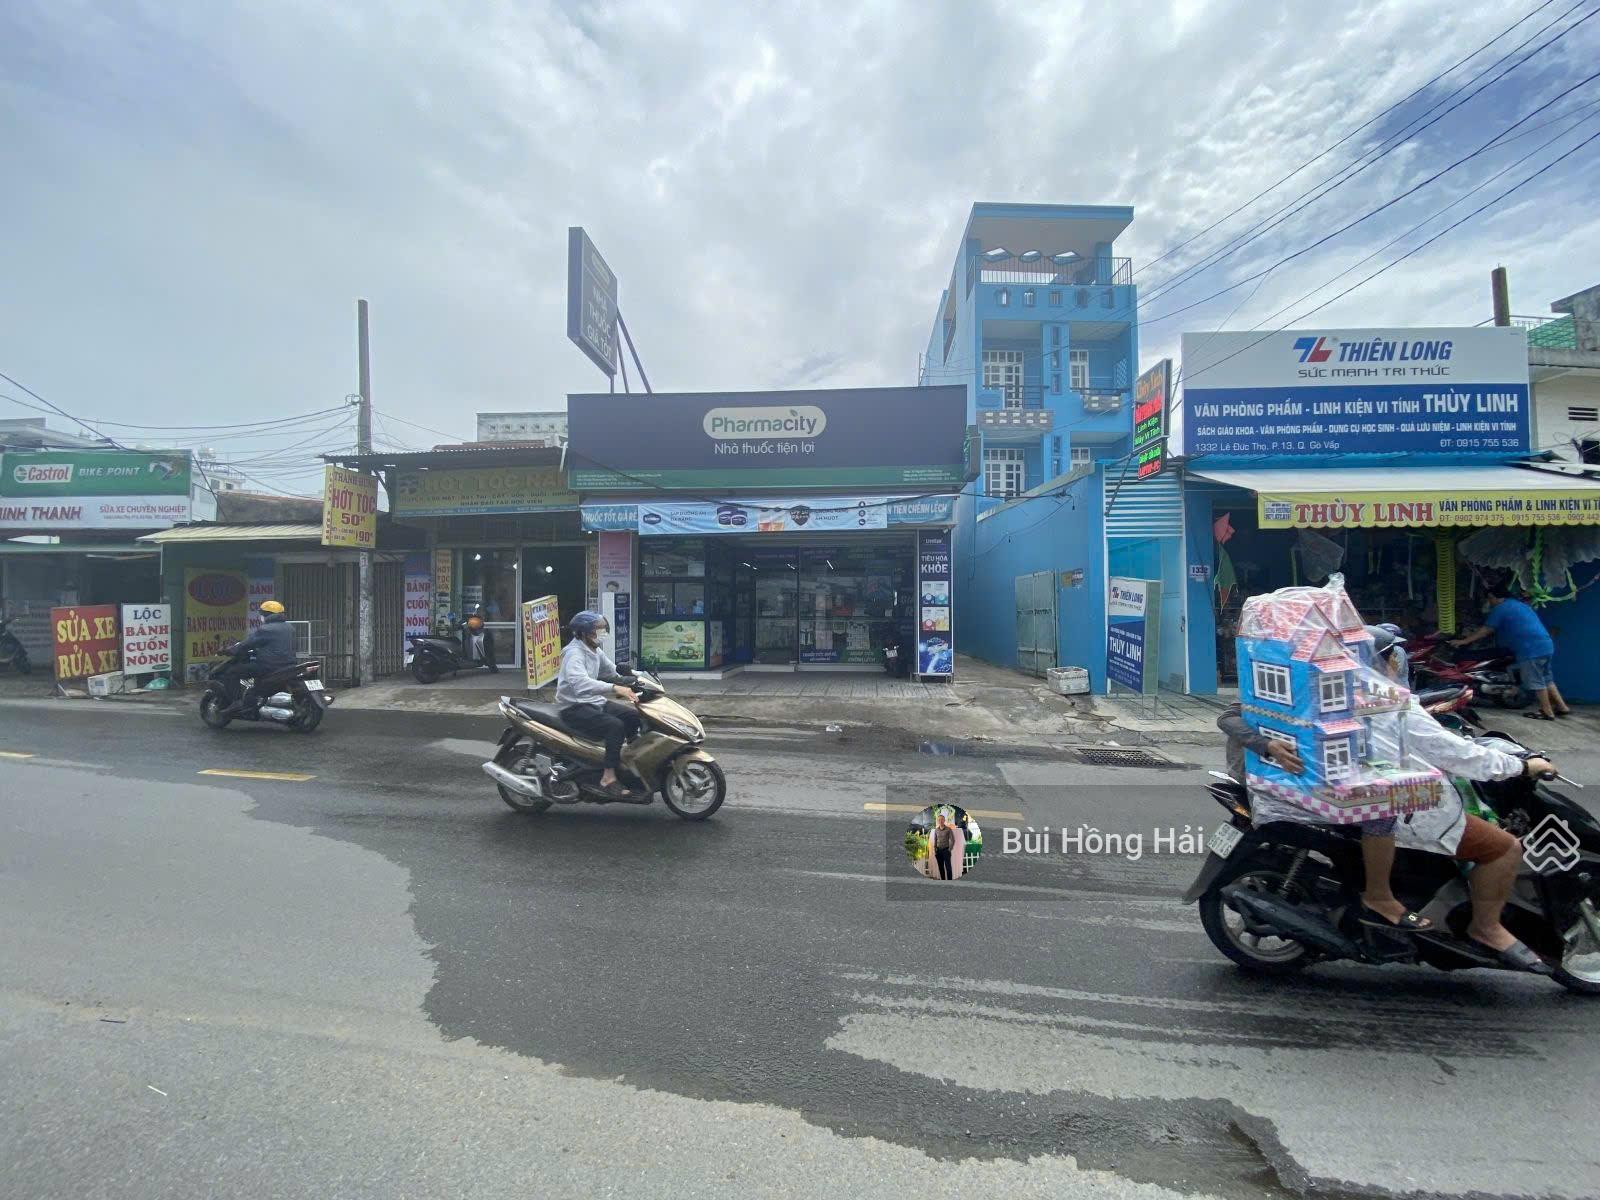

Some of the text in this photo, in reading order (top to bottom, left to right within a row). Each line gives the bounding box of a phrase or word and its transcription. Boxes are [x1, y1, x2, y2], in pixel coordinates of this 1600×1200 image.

[1339, 337, 1397, 362] THIÊN
[1399, 340, 1453, 362] LONG
[1380, 367, 1405, 376] TRI
[1194, 387, 1519, 418] VĂN PHÒNG PHẨM LINH KIỆN VI TÍNH THÙY LINH
[711, 413, 817, 435] Pharmacity
[1197, 424, 1216, 437] SÁCH
[1217, 424, 1234, 436] GIÁO
[1235, 426, 1255, 435] KHOA
[1260, 425, 1275, 435] VĂN
[1277, 423, 1301, 435] PHÒNG
[1302, 421, 1323, 434] PHẨM
[1361, 423, 1376, 435] HỌC
[1377, 423, 1395, 433] SINH
[1456, 422, 1473, 432] LINH
[1491, 422, 1499, 431] VI
[714, 439, 816, 456] Nhà thuốc tiện lợi
[1195, 442, 1218, 452] 1332
[1456, 438, 1480, 448] 0915
[1483, 438, 1499, 447] 755
[1502, 438, 1520, 447] 536
[29, 466, 141, 481] Castrol BIKE POINT
[115, 505, 126, 513] XE
[126, 503, 157, 513] CHUYÊN
[357, 489, 377, 514] TÓC
[908, 500, 930, 514] CHÊNH
[1439, 496, 1591, 514] VĂN PHÒNG PHẨM & LINH KIỆN VI
[1295, 498, 1366, 523] THÙY
[1373, 502, 1434, 523] LINH
[921, 553, 935, 562] TIÊU
[921, 561, 949, 574] KHỎE
[133, 607, 162, 624] LỘC
[57, 610, 91, 644] SỬA
[95, 616, 116, 640] XE
[125, 624, 169, 637] BÁNH
[126, 636, 168, 653] CUỐN
[1125, 642, 1142, 663] LINH
[58, 645, 118, 678] RỬA XE
[126, 652, 169, 667] NÓNG
